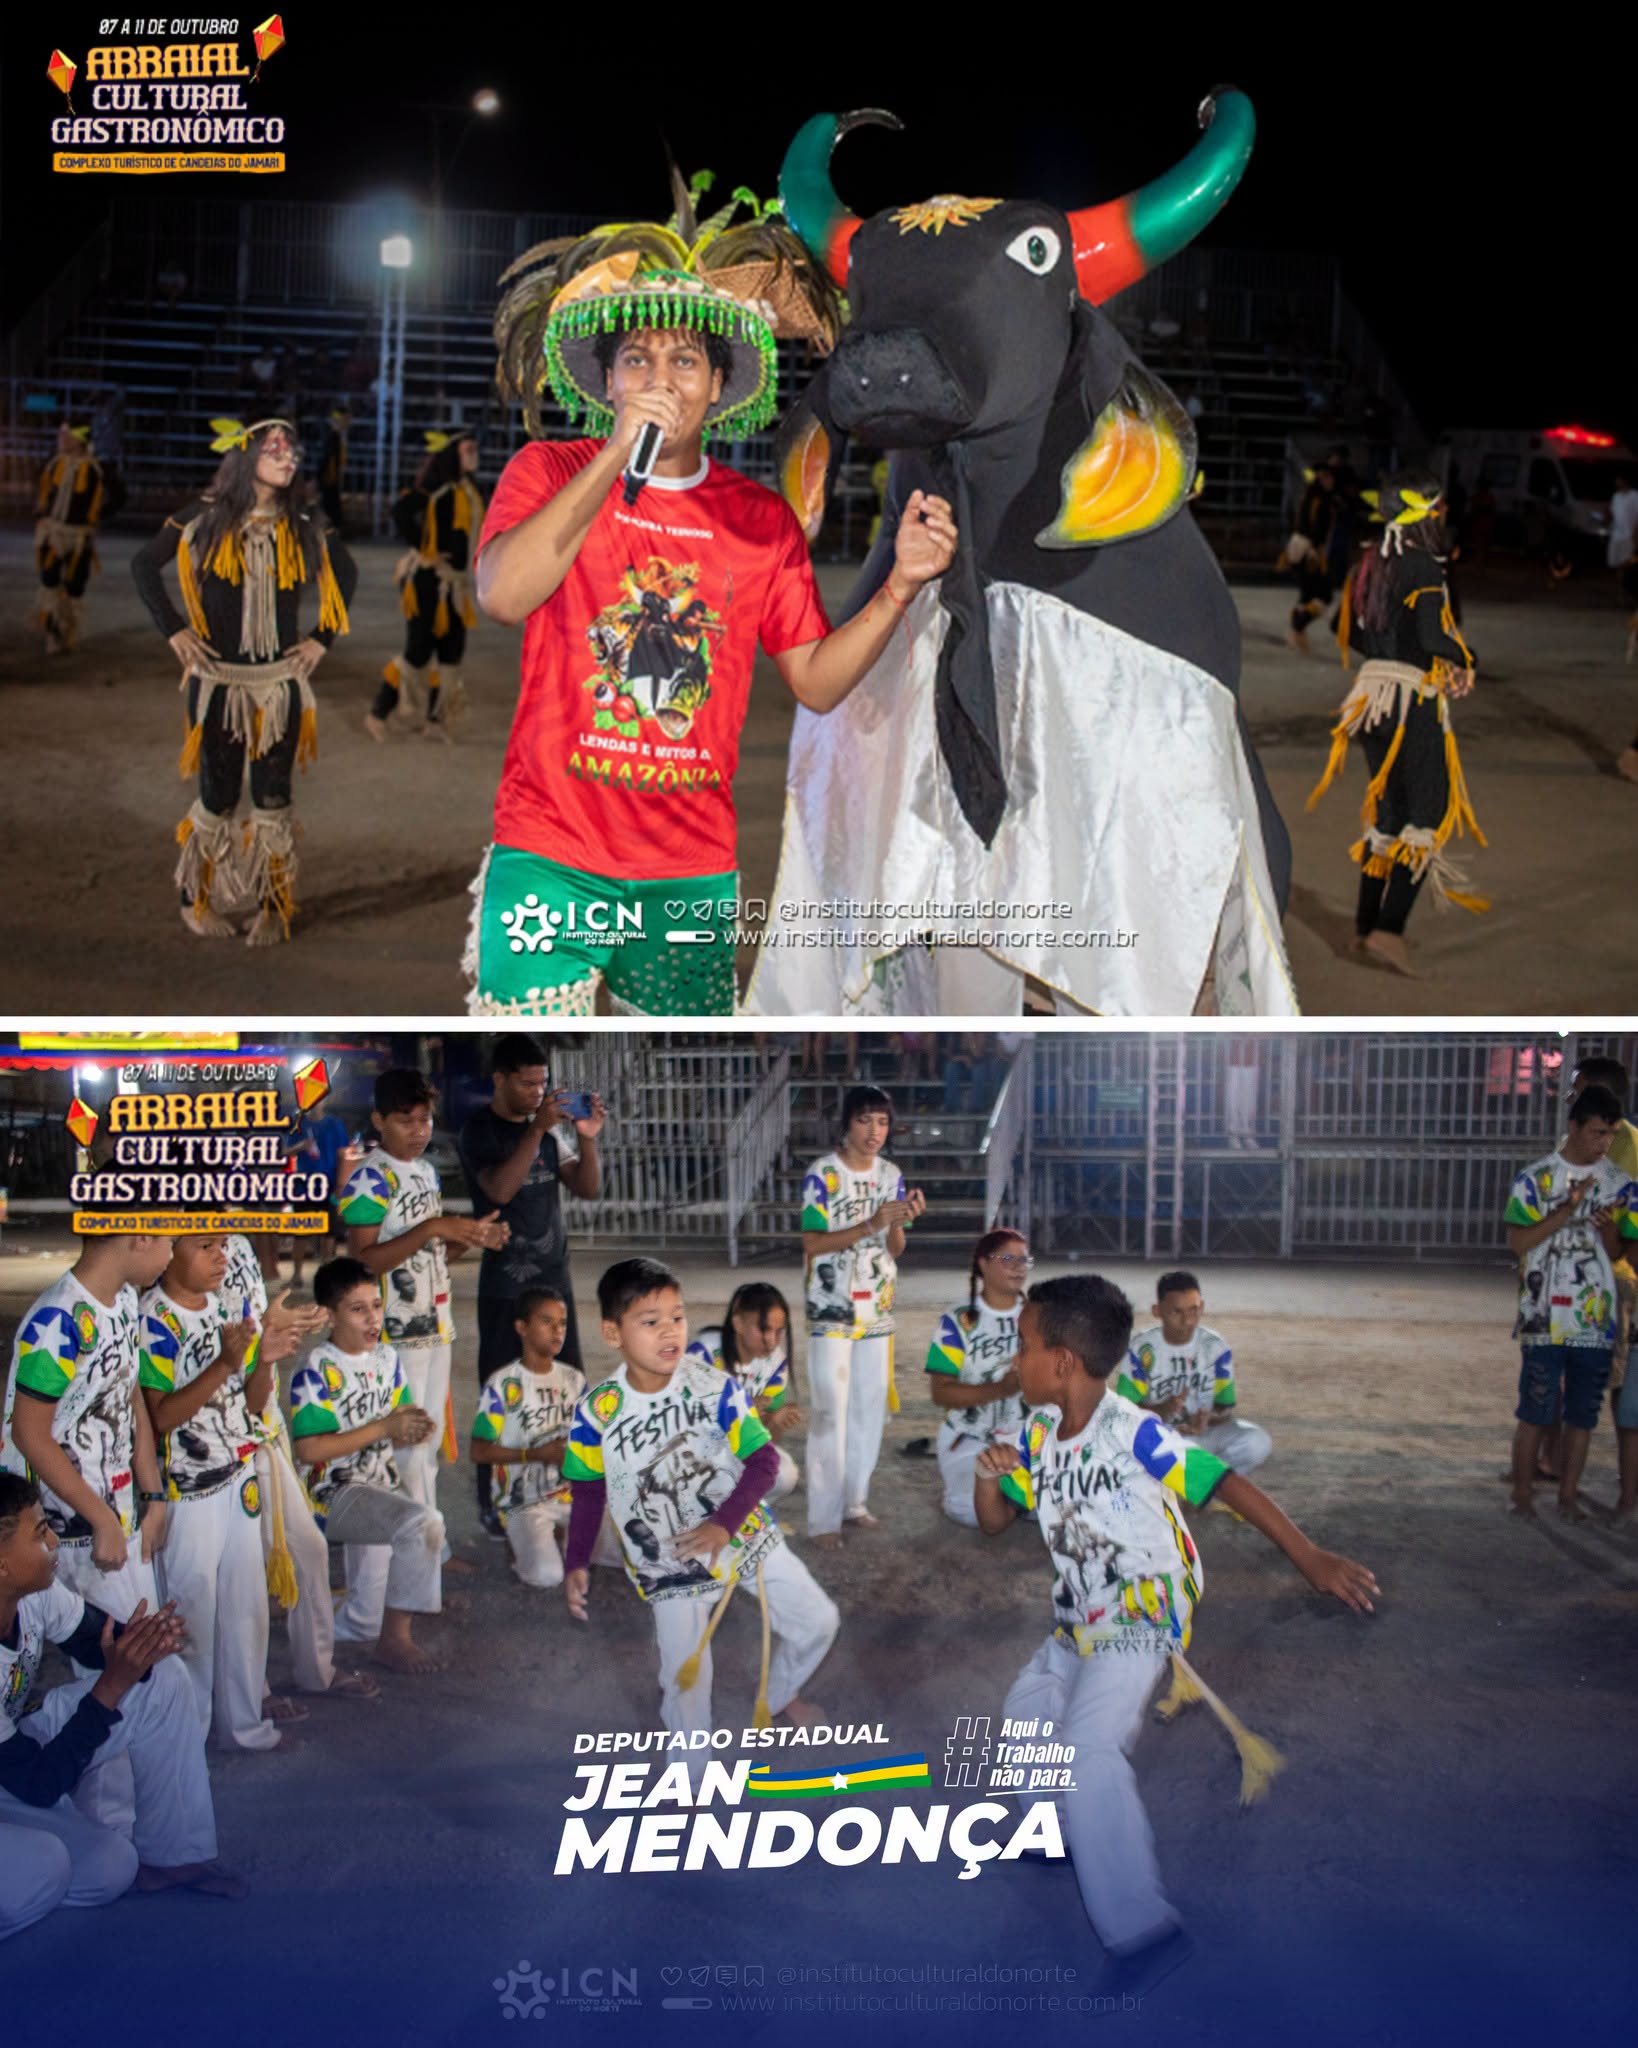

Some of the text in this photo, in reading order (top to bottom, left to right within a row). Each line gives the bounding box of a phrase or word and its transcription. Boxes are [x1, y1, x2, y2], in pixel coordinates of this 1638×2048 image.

[579, 733, 637, 754] LENDAS
[642, 744, 651, 756] E
[655, 746, 697, 760] MITOS
[565, 751, 721, 795] AMAZÔNIA
[607, 1399, 713, 1462] FESTIVA
